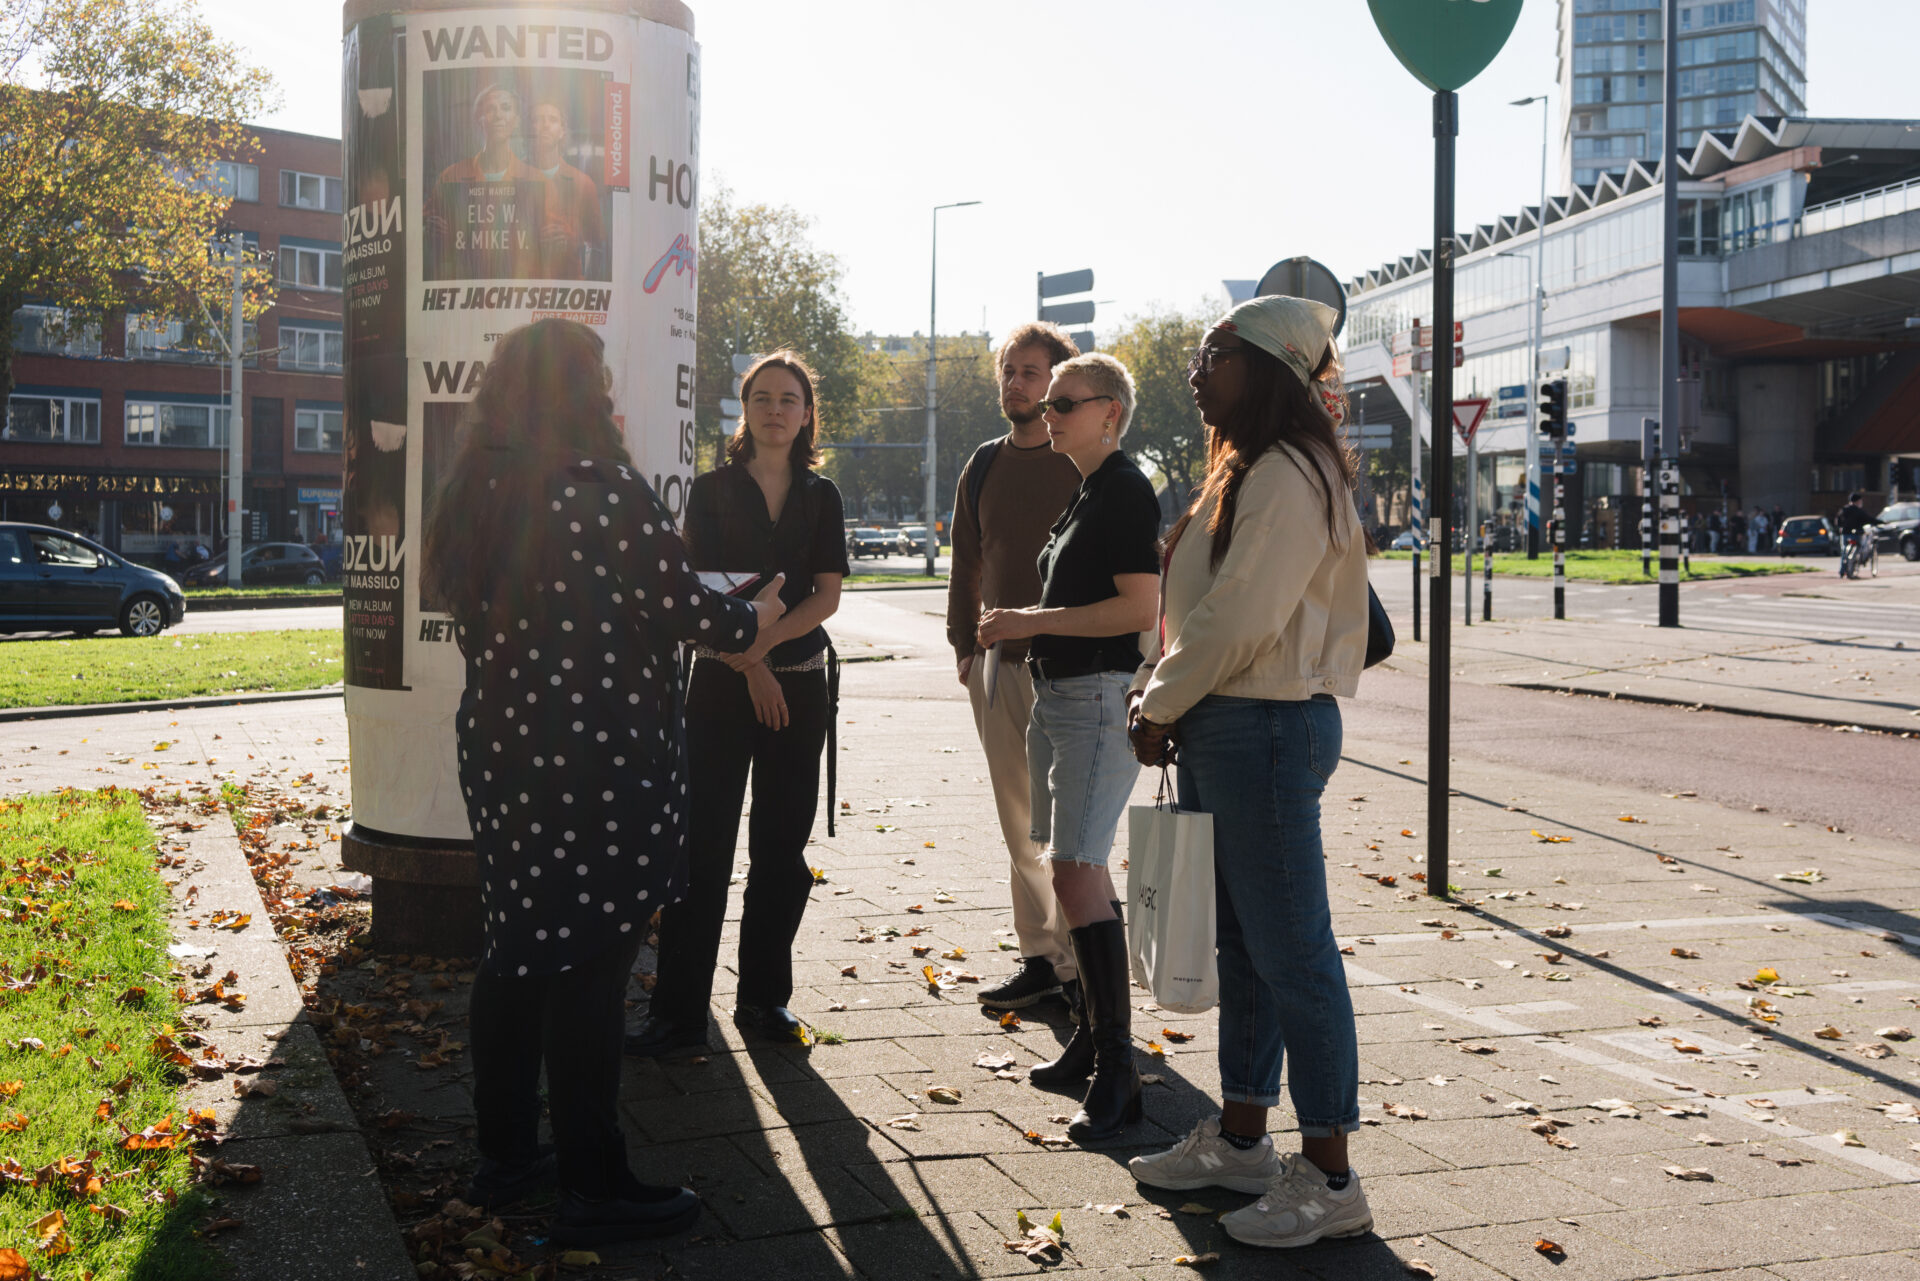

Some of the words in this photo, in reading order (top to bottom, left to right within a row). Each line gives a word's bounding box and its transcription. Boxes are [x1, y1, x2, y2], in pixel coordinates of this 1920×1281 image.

[422, 25, 614, 62] WANTED
[468, 187, 486, 197] MOST
[488, 187, 516, 196] WANTED
[467, 204, 496, 224] ELS
[502, 203, 520, 224] W.
[455, 231, 466, 250] &
[471, 230, 510, 250] MIKE
[516, 230, 530, 250] V.
[360, 264, 386, 280] ALBUM
[367, 277, 389, 294] DAYS
[362, 294, 382, 308] NOW
[422, 288, 461, 311] HET
[460, 286, 612, 312] JACHTSEIZOEN
[679, 419, 694, 466] IS
[350, 575, 400, 590] MAASSILO
[363, 600, 392, 612] ALBUM
[372, 614, 395, 626] DAYS
[366, 628, 387, 640] NOW
[419, 619, 455, 642] HET
